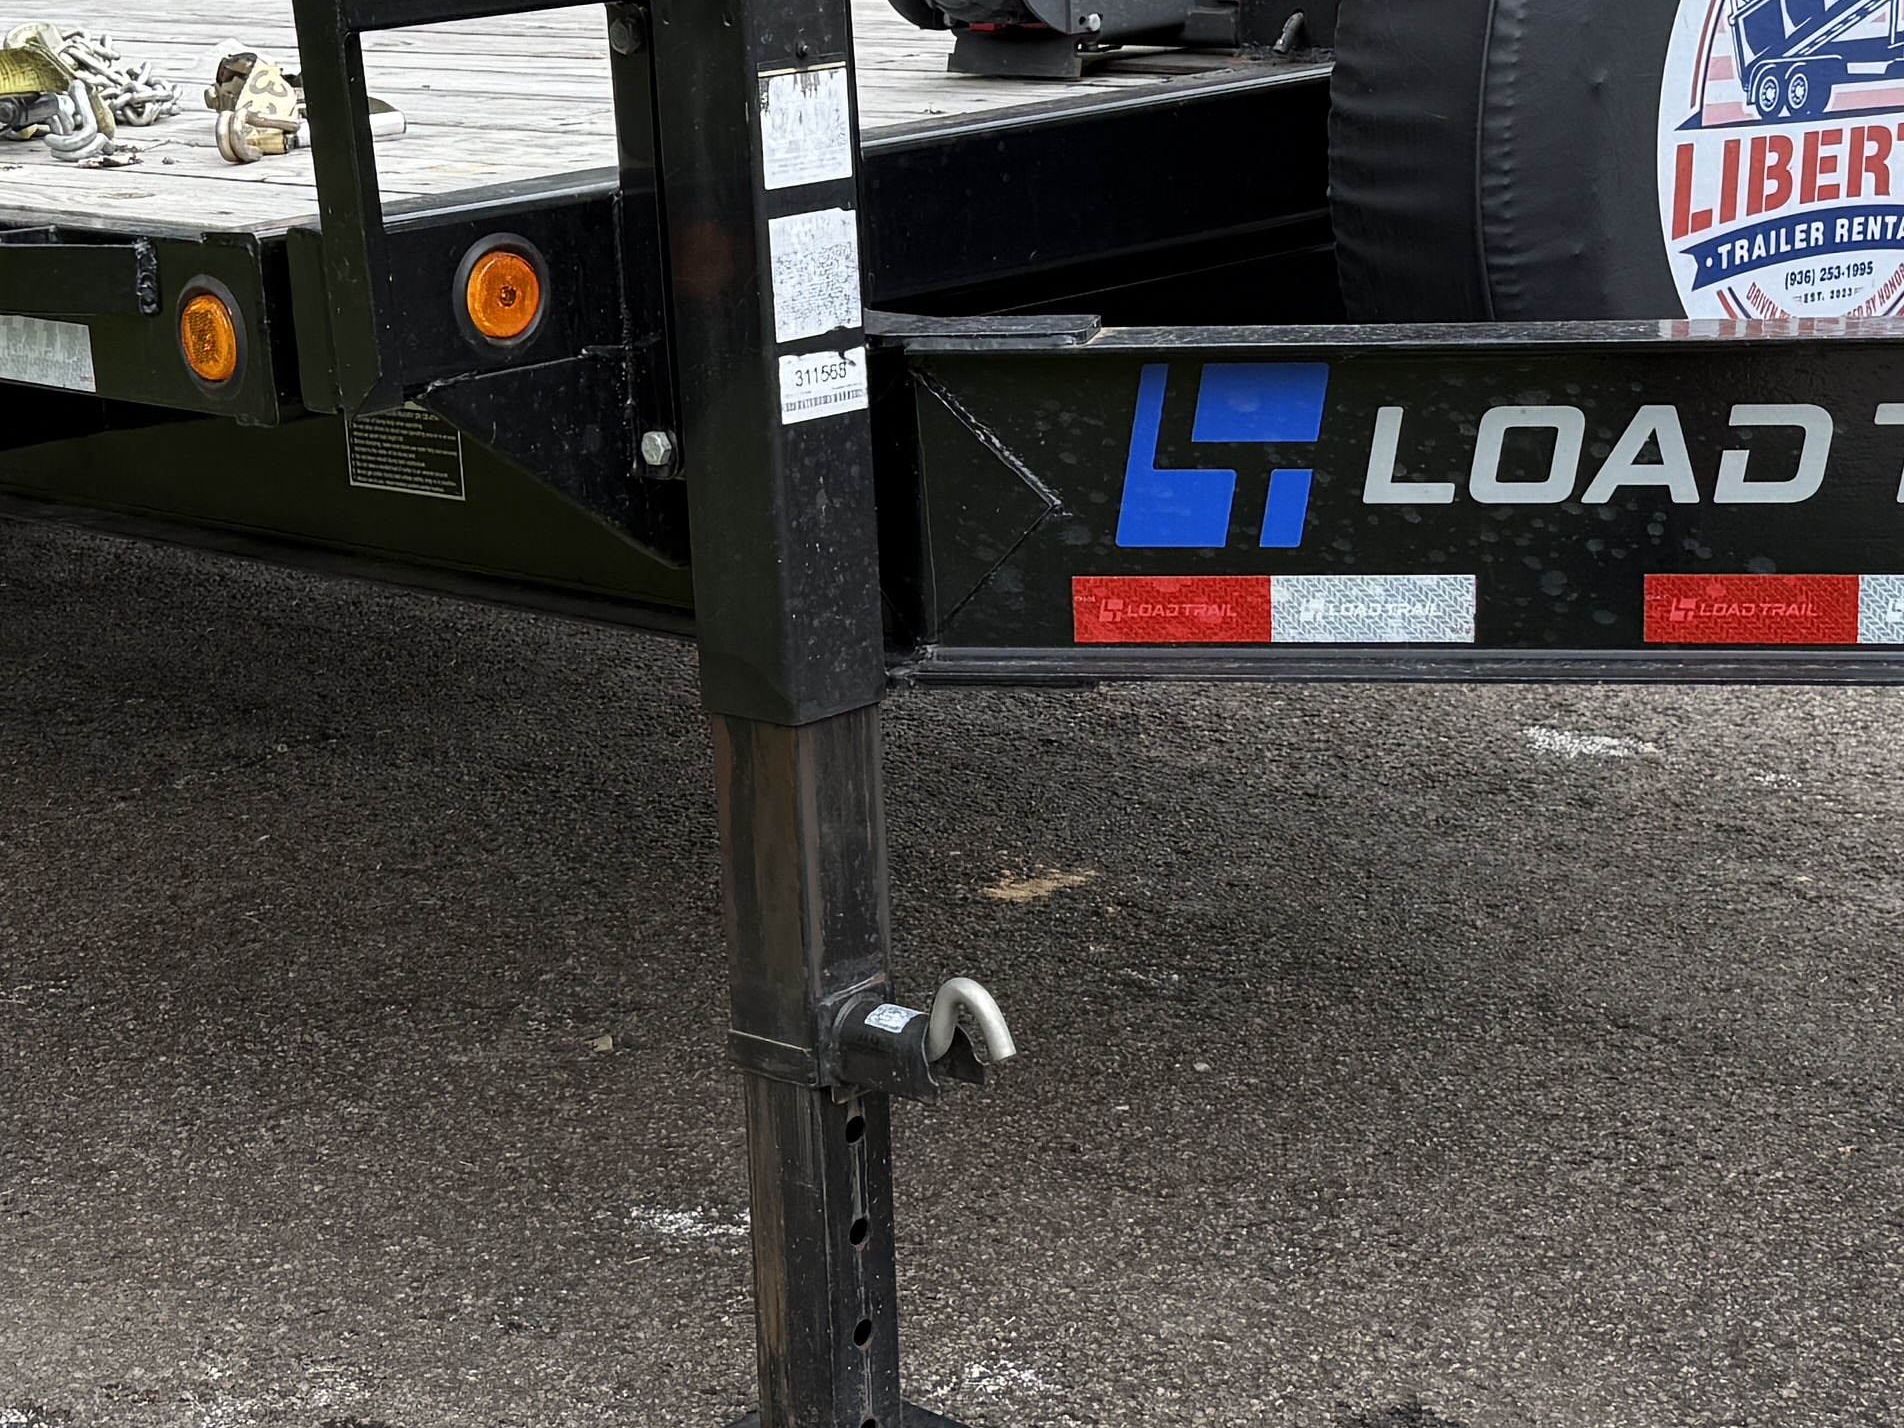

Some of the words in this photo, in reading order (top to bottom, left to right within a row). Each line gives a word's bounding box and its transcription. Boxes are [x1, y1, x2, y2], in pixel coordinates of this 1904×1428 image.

[1716, 222, 1825, 271] TRAILER
[1784, 266, 1816, 290] (936)
[1803, 291, 1825, 304] EST.
[1829, 287, 1853, 300] 2023
[1363, 404, 1834, 505] LOAD
[1127, 603, 1180, 618] LOAD
[1180, 603, 1238, 618] TRAIL
[1699, 602, 1756, 617] LOAD
[1758, 602, 1818, 617] TRAIL
